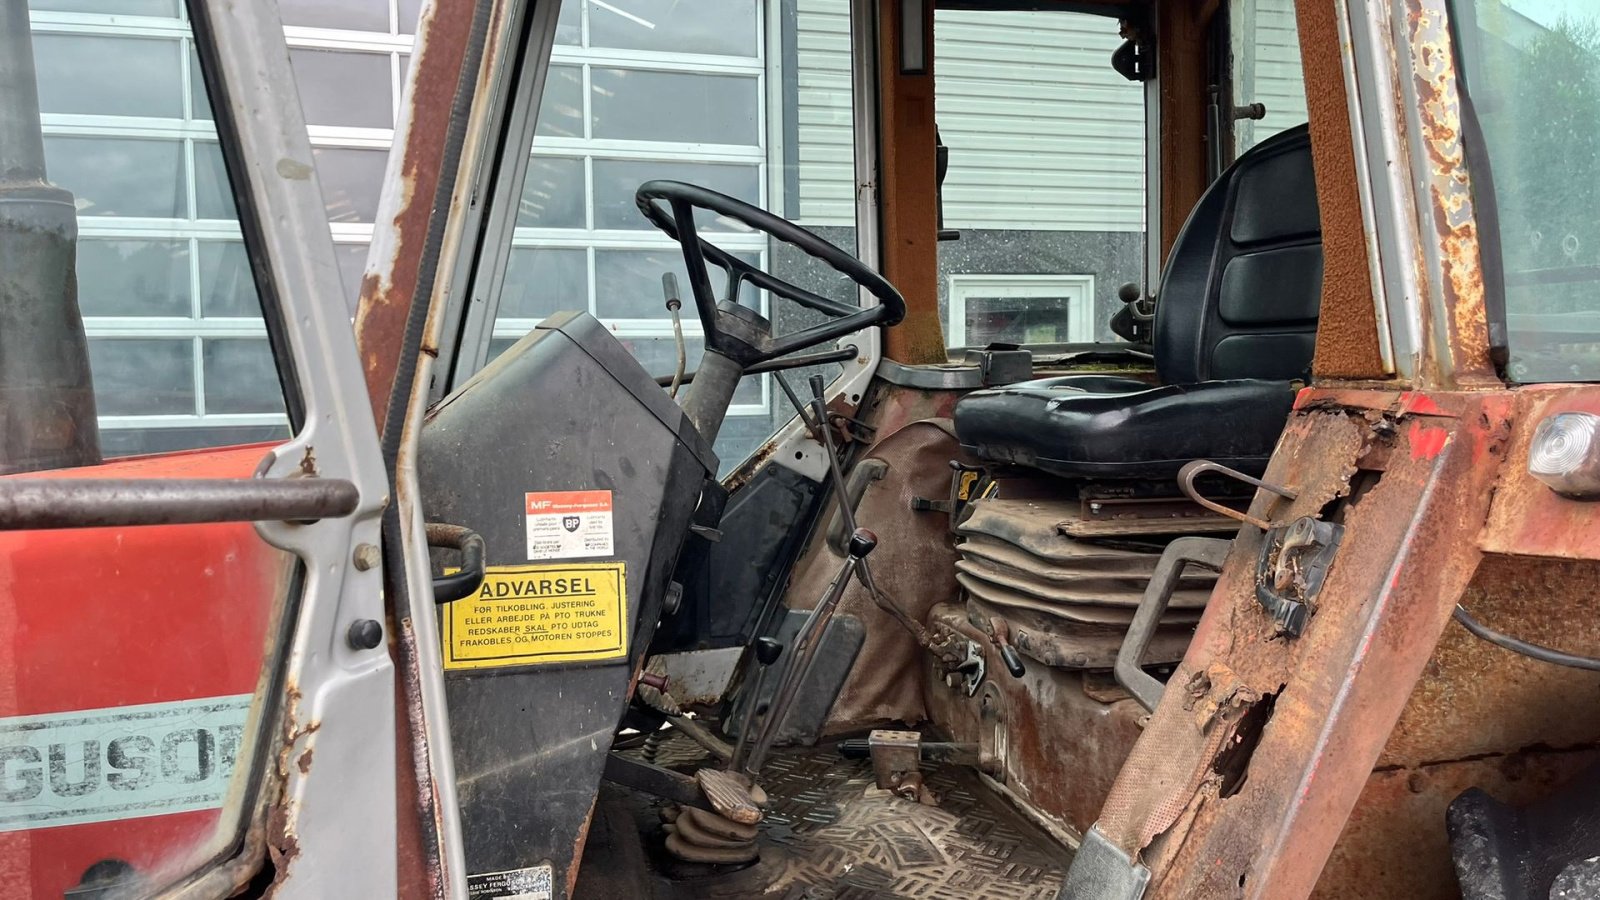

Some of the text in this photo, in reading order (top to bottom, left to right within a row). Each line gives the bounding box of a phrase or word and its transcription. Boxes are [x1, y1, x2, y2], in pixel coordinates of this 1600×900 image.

[530, 500, 552, 510] MF
[565, 518, 579, 529] BP
[480, 578, 596, 597] ADVARSEL
[474, 605, 492, 614] FØR
[550, 600, 596, 610] JUSTERING
[465, 616, 492, 625] ELLER
[497, 613, 535, 623] ARBEJDE
[554, 612, 571, 620] PTO
[575, 609, 606, 618] TRUKNE
[468, 620, 599, 636] REDSKABER SKAL PTO UDTAG
[460, 637, 512, 647] FRAKOBLES
[531, 632, 572, 642] MOTOREN
[576, 630, 612, 639] STOPPES
